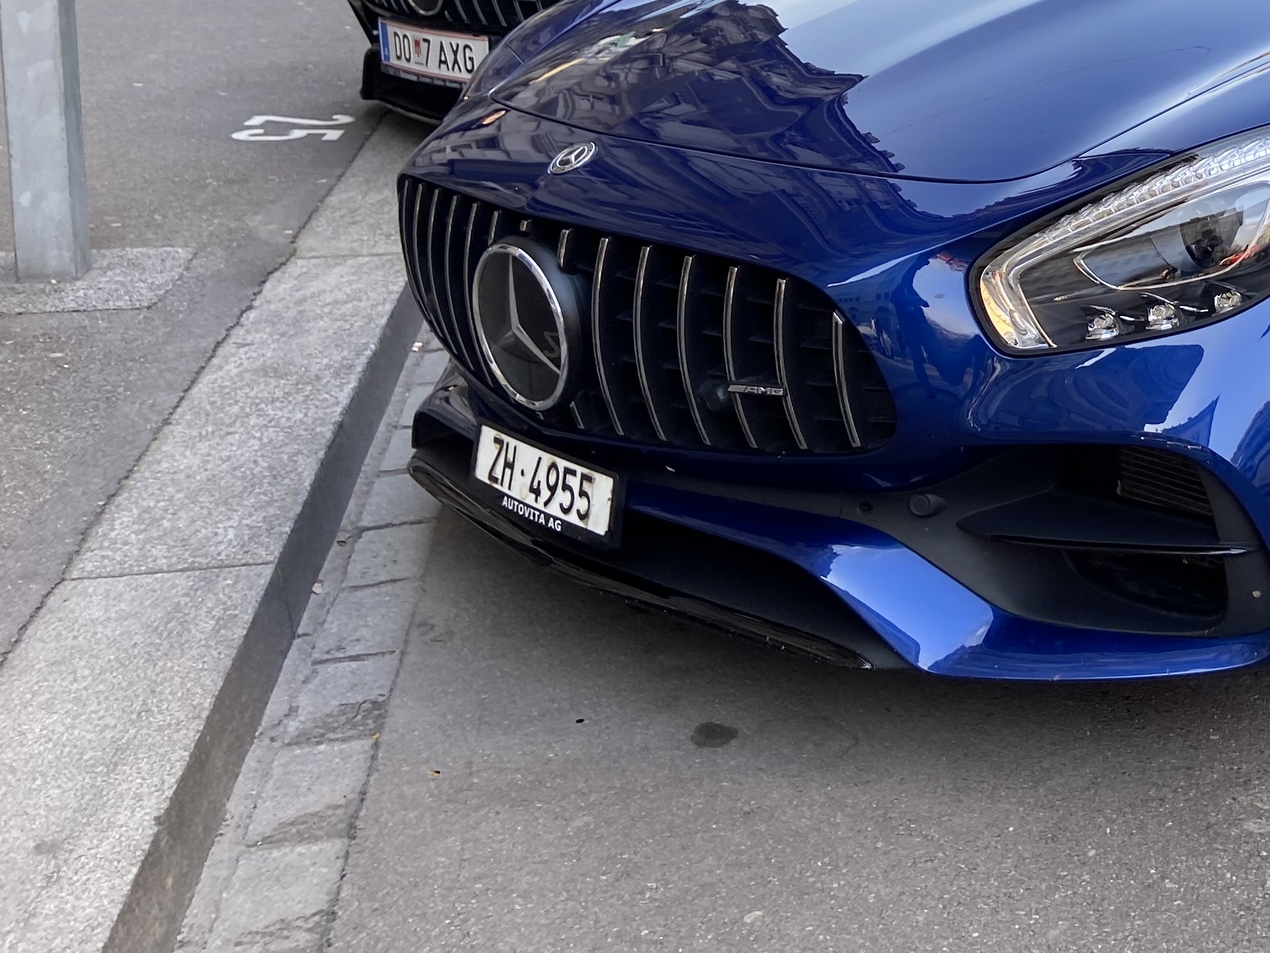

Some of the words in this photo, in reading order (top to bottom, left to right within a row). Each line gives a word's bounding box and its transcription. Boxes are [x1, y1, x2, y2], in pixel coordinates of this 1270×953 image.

[393, 31, 412, 63] DO
[422, 37, 431, 67] 7
[438, 40, 475, 74] AXG
[745, 386, 784, 396] AMG
[502, 495, 546, 526] AUTOVITA
[547, 517, 562, 532] AG
